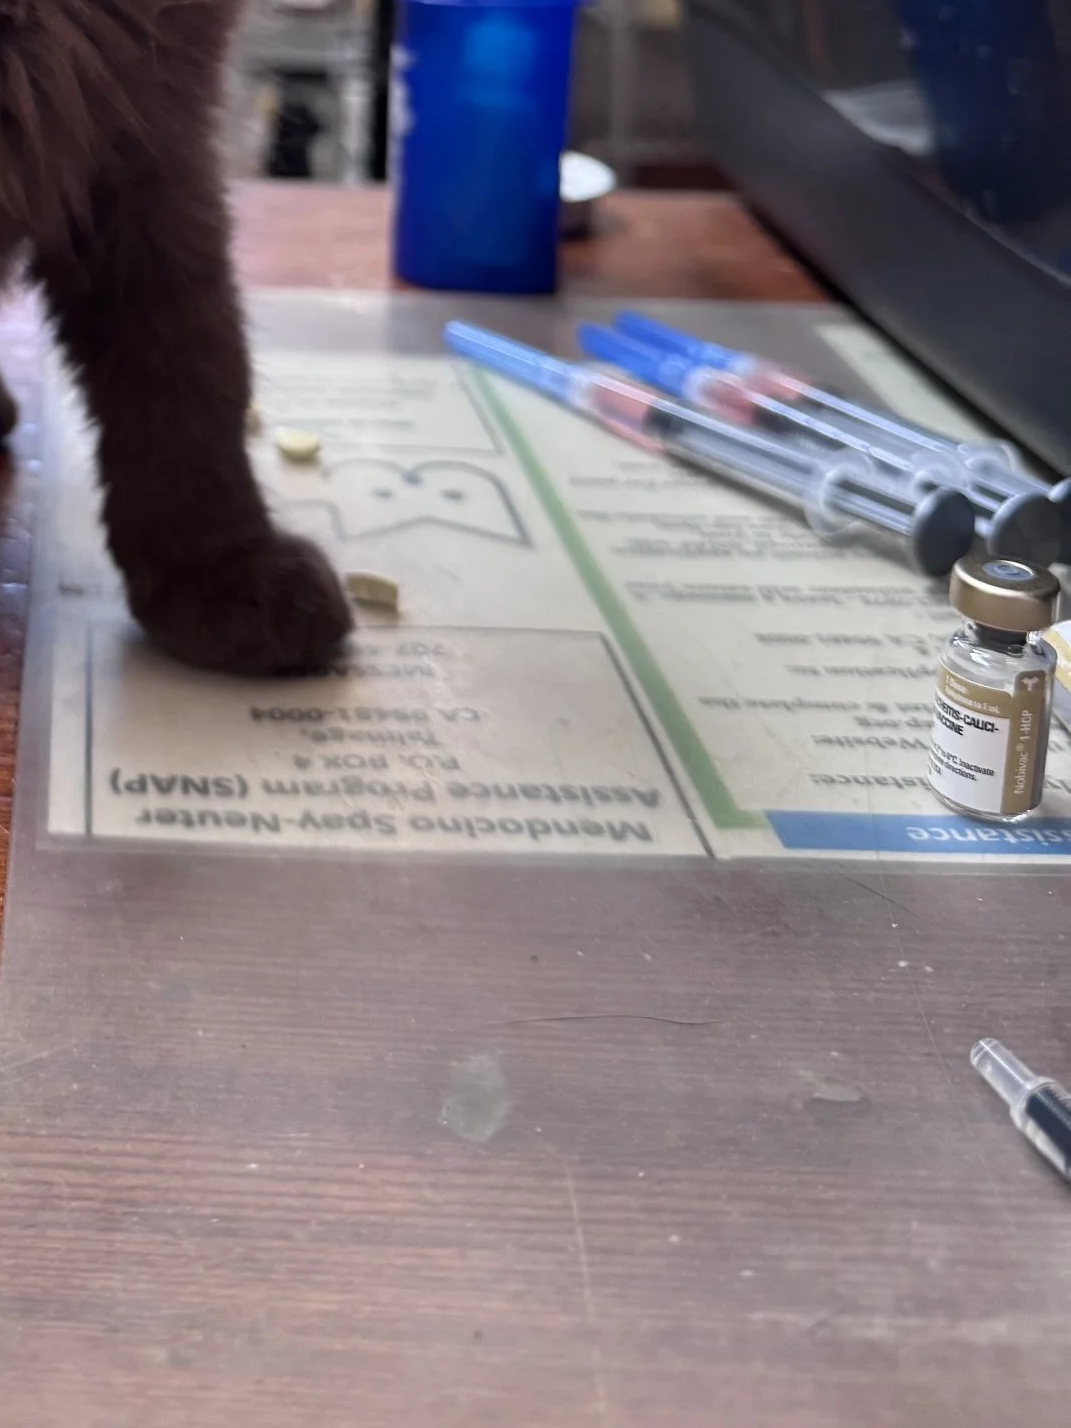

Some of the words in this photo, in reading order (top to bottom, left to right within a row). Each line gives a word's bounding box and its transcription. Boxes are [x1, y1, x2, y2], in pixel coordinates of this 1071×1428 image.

[435, 706, 481, 723] CA
[1019, 709, 1033, 740] 1-HCP
[108, 767, 250, 801] (SNAP)
[261, 776, 438, 806] Program
[444, 782, 661, 809] Assistance
[134, 808, 397, 835] Spay-Neuter
[407, 815, 654, 844] Mendocino
